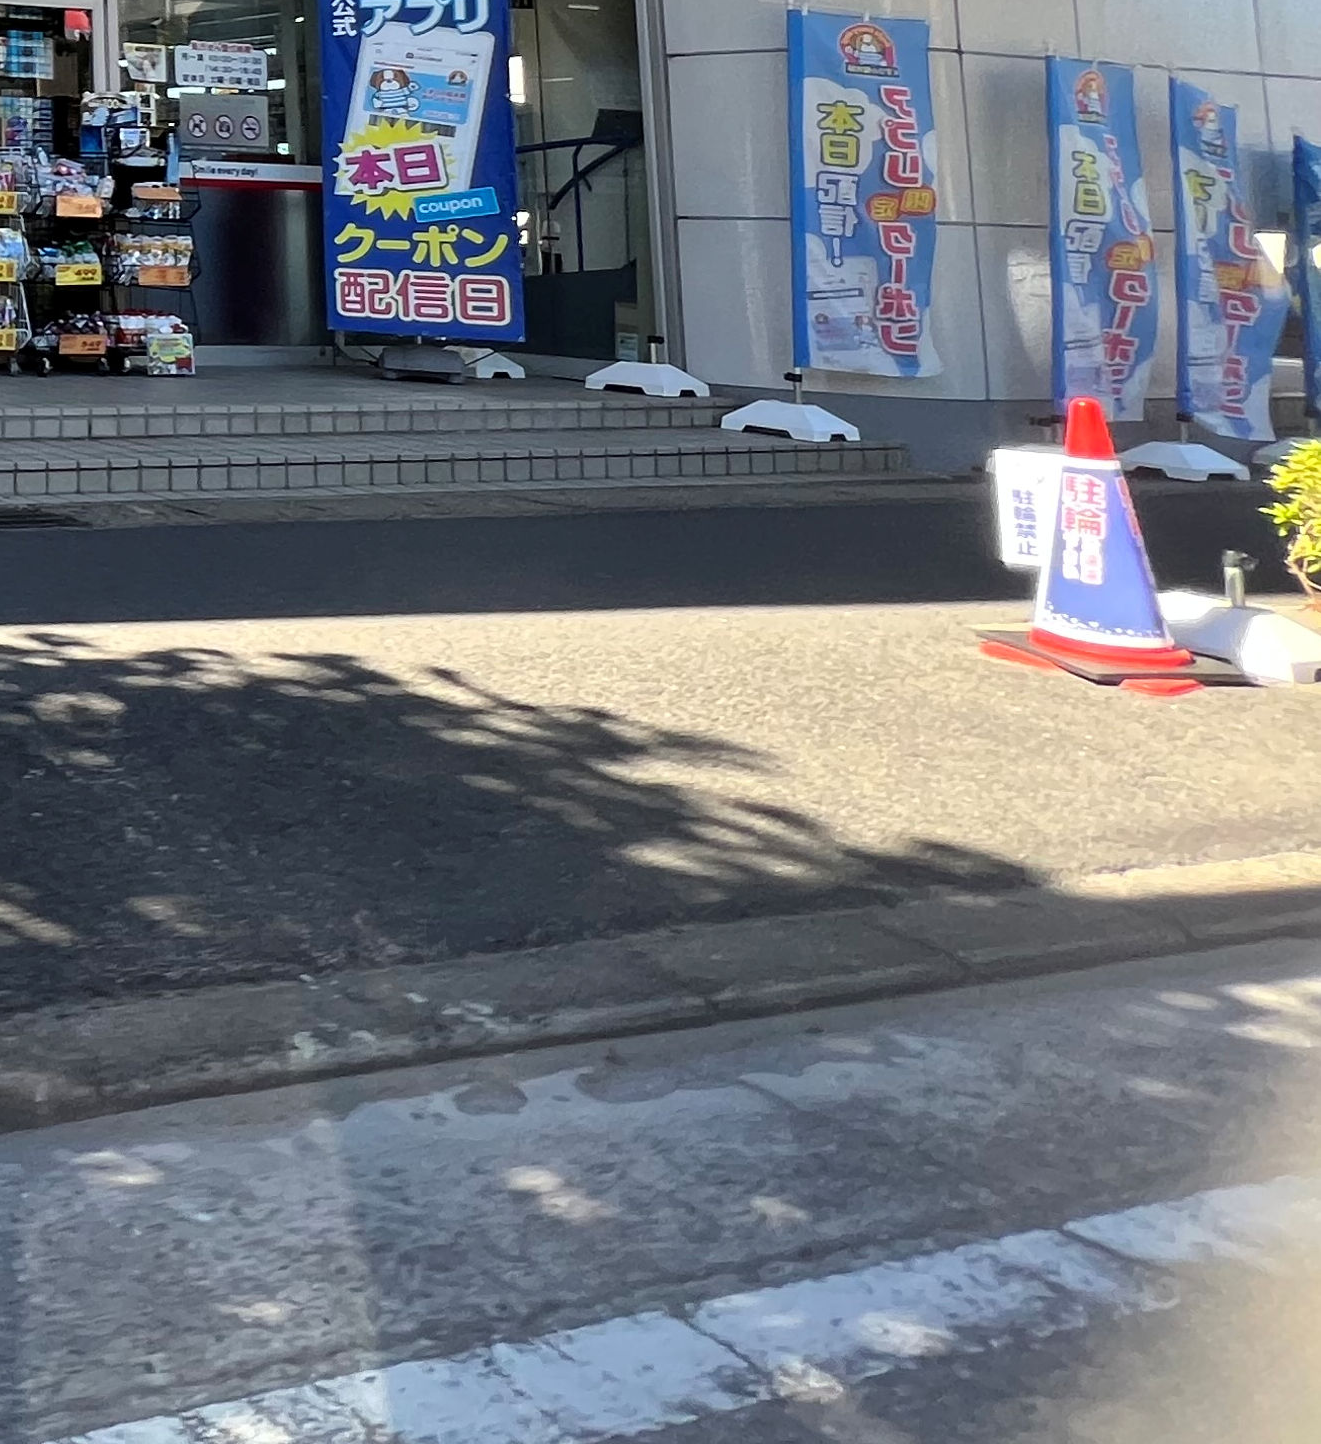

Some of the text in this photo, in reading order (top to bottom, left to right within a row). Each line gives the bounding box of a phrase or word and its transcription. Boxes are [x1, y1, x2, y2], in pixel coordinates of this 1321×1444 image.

[345, 143, 442, 191] 本日
[418, 196, 483, 214] coupon
[334, 223, 508, 267] クーポン
[334, 268, 511, 326] 配信日
